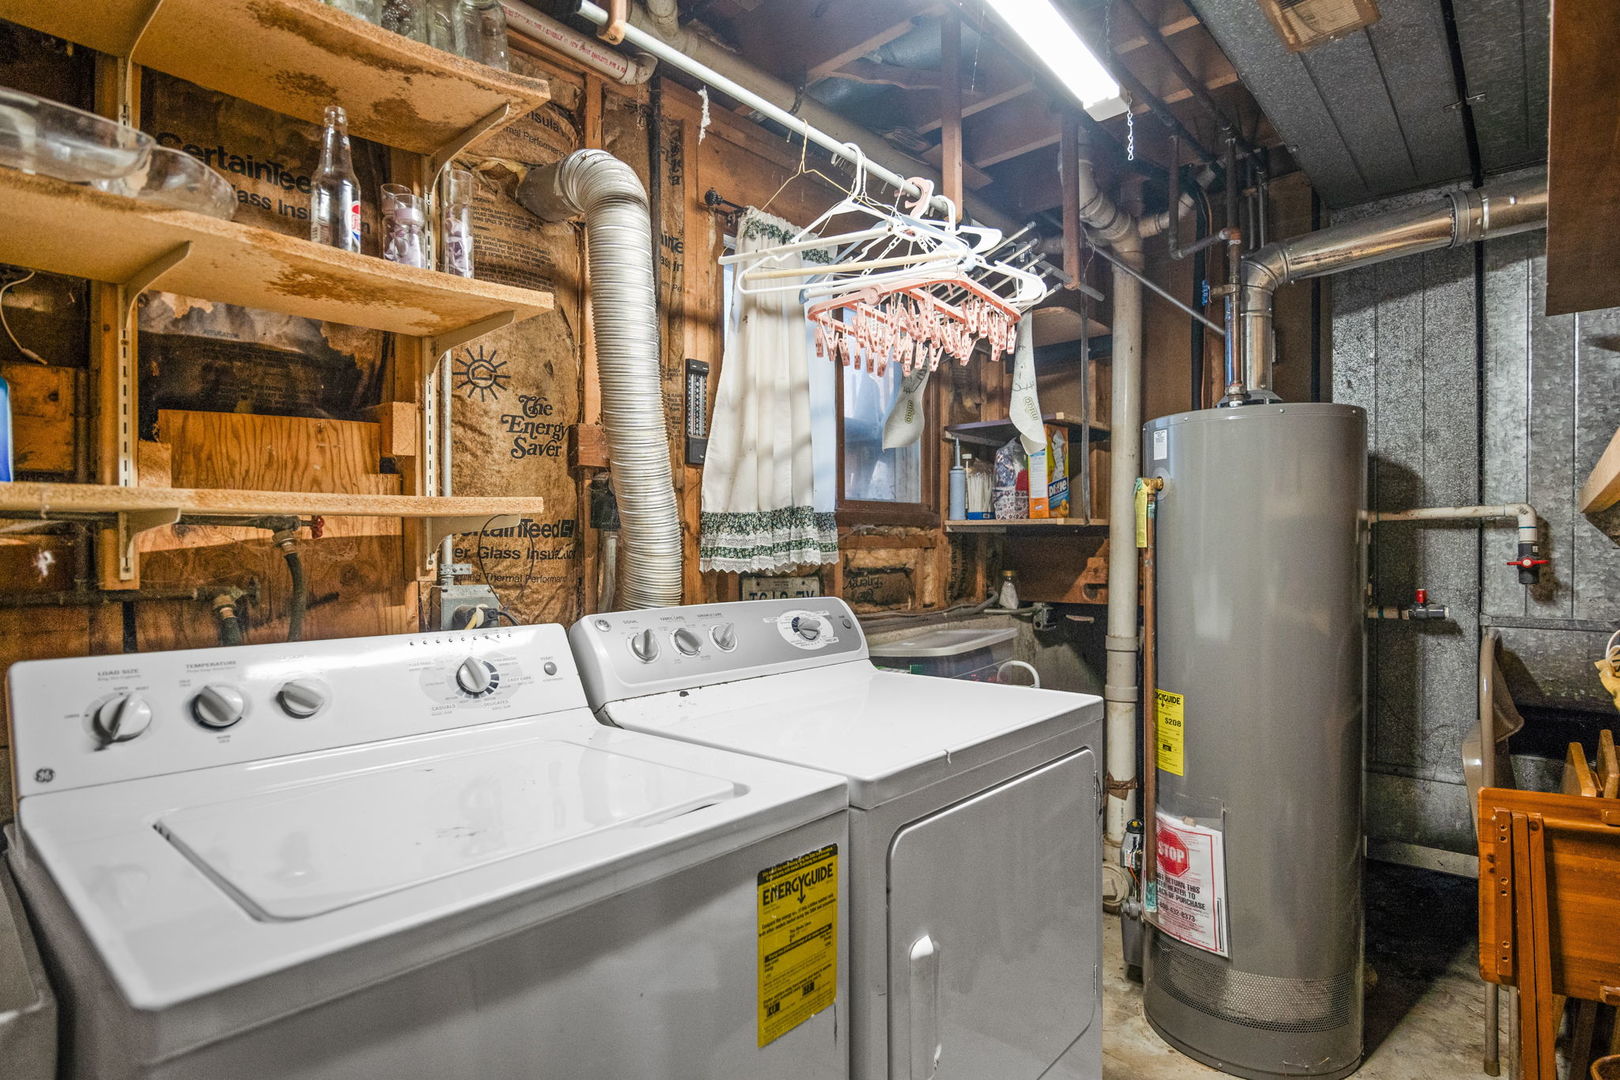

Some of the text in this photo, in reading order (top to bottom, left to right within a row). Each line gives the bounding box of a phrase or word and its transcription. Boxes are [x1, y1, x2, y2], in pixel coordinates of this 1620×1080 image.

[155, 131, 312, 194] CertainTee
[518, 394, 553, 418] The
[500, 414, 570, 441] Energy
[511, 437, 562, 459] Saver
[478, 546, 521, 560] Glass
[486, 573, 522, 582] Thermal
[185, 660, 236, 669] TEMPERATURE
[1158, 841, 1185, 863] STOP
[762, 862, 834, 906] ENERGYGUIDE
[1186, 883, 1201, 894] THIS
[1175, 894, 1206, 911] PURCHASE
[1187, 891, 1196, 900] TO
